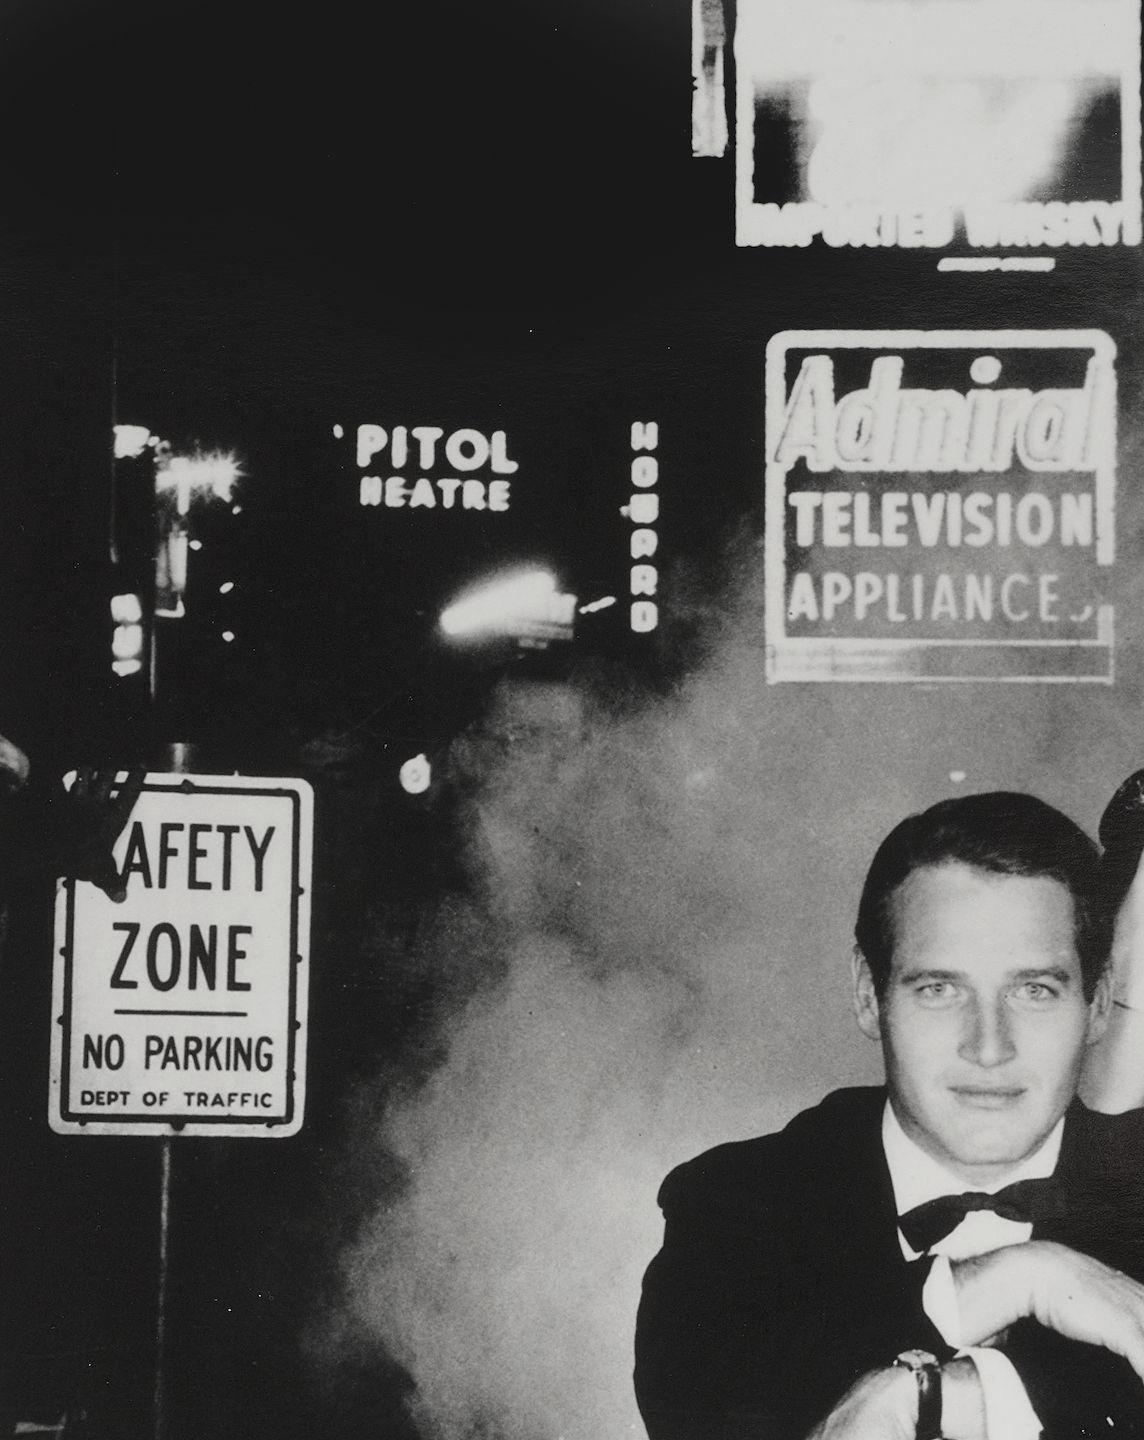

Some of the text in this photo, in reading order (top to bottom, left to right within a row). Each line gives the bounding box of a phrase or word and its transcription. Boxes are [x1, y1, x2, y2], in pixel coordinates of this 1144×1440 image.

[773, 354, 1115, 473] Admiral
[356, 423, 520, 474] PITOL
[359, 475, 511, 512] HEATRE
[788, 491, 1093, 548] TELEVISION
[120, 820, 276, 892] AFETY
[110, 922, 252, 992] ZONE
[82, 1033, 274, 1073] NO PARKING
[80, 1089, 273, 1109] DEPT OF TRAFFIC
